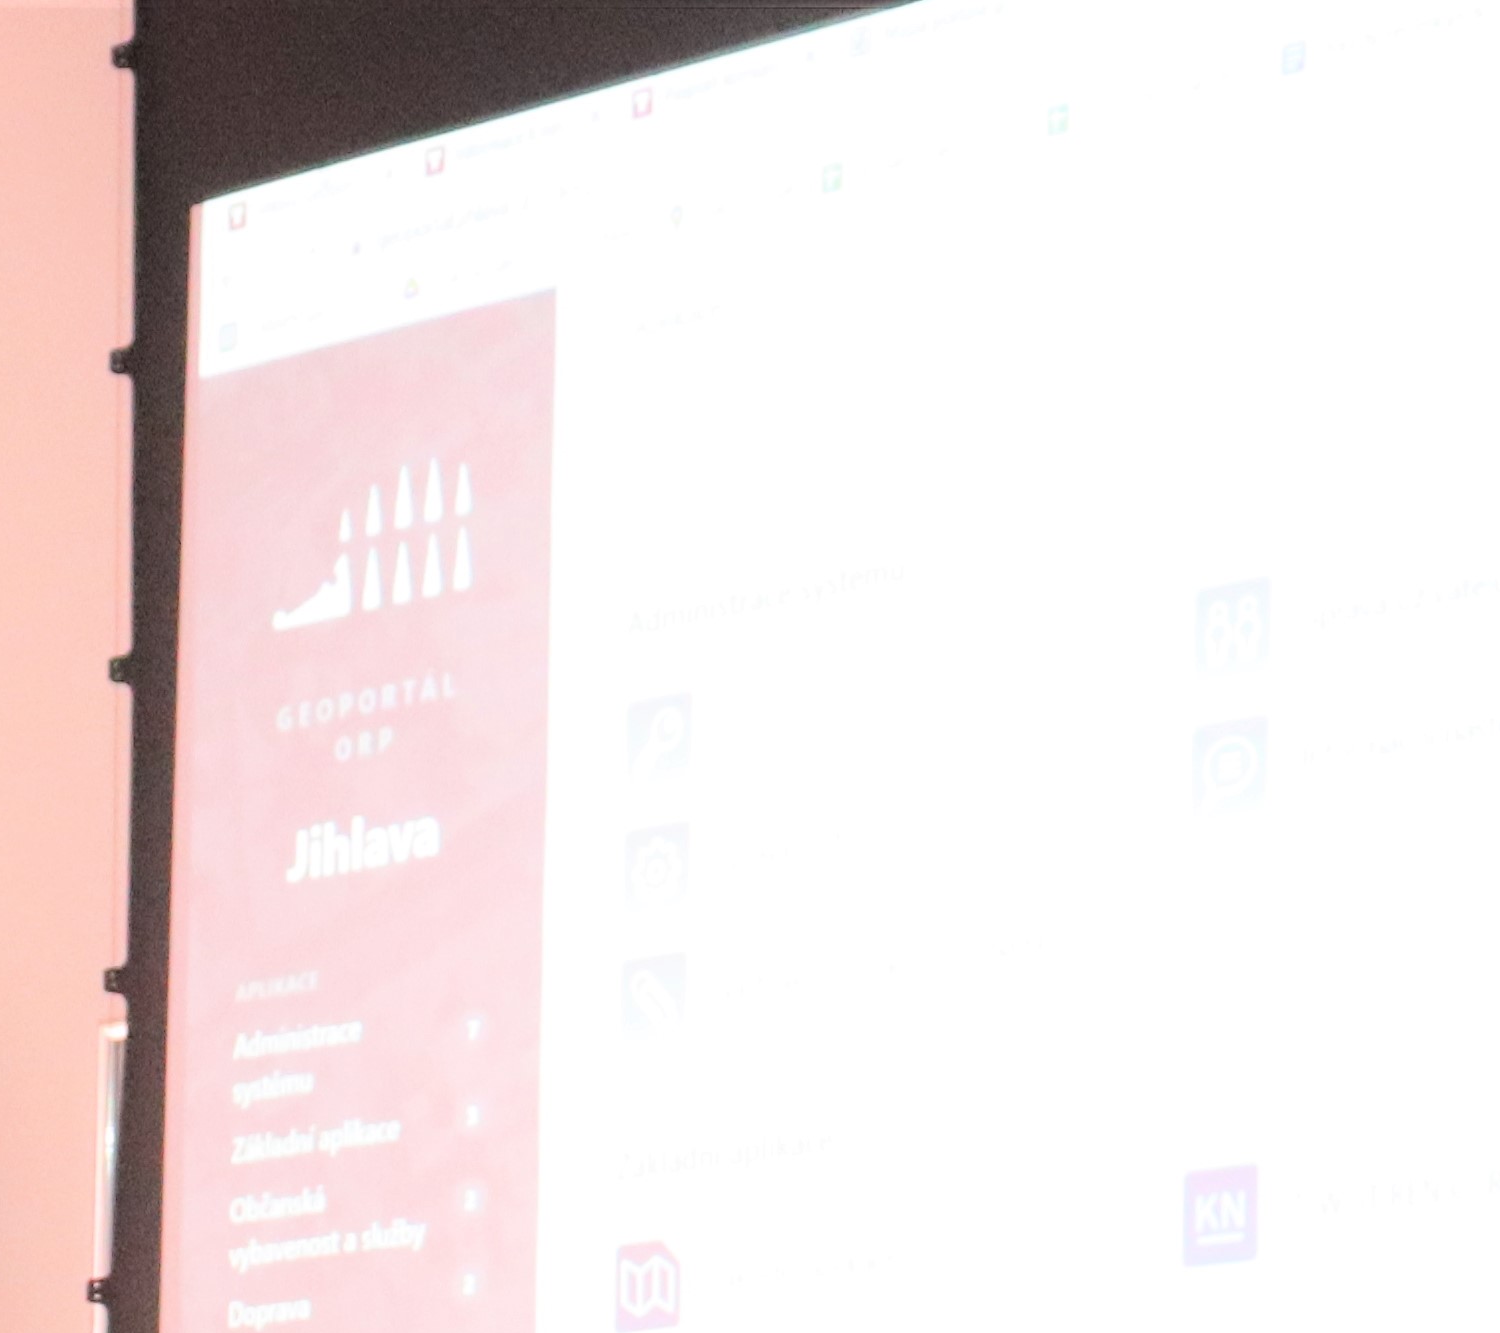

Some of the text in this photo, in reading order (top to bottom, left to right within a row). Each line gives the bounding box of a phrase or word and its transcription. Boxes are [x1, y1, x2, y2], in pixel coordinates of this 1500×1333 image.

[333, 725, 395, 763] ORP
[285, 815, 441, 884] Jihlava
[235, 969, 319, 1003] APLIKACE
[232, 1020, 363, 1061] Administrace
[231, 1069, 315, 1110] systému
[231, 1122, 317, 1165] Základní
[318, 1118, 403, 1158] aplikace
[229, 1184, 327, 1224] Občanská
[1194, 1191, 1246, 1232] KN
[228, 1217, 428, 1275] vybavenost a služby
[227, 1298, 312, 1332] Doprava
